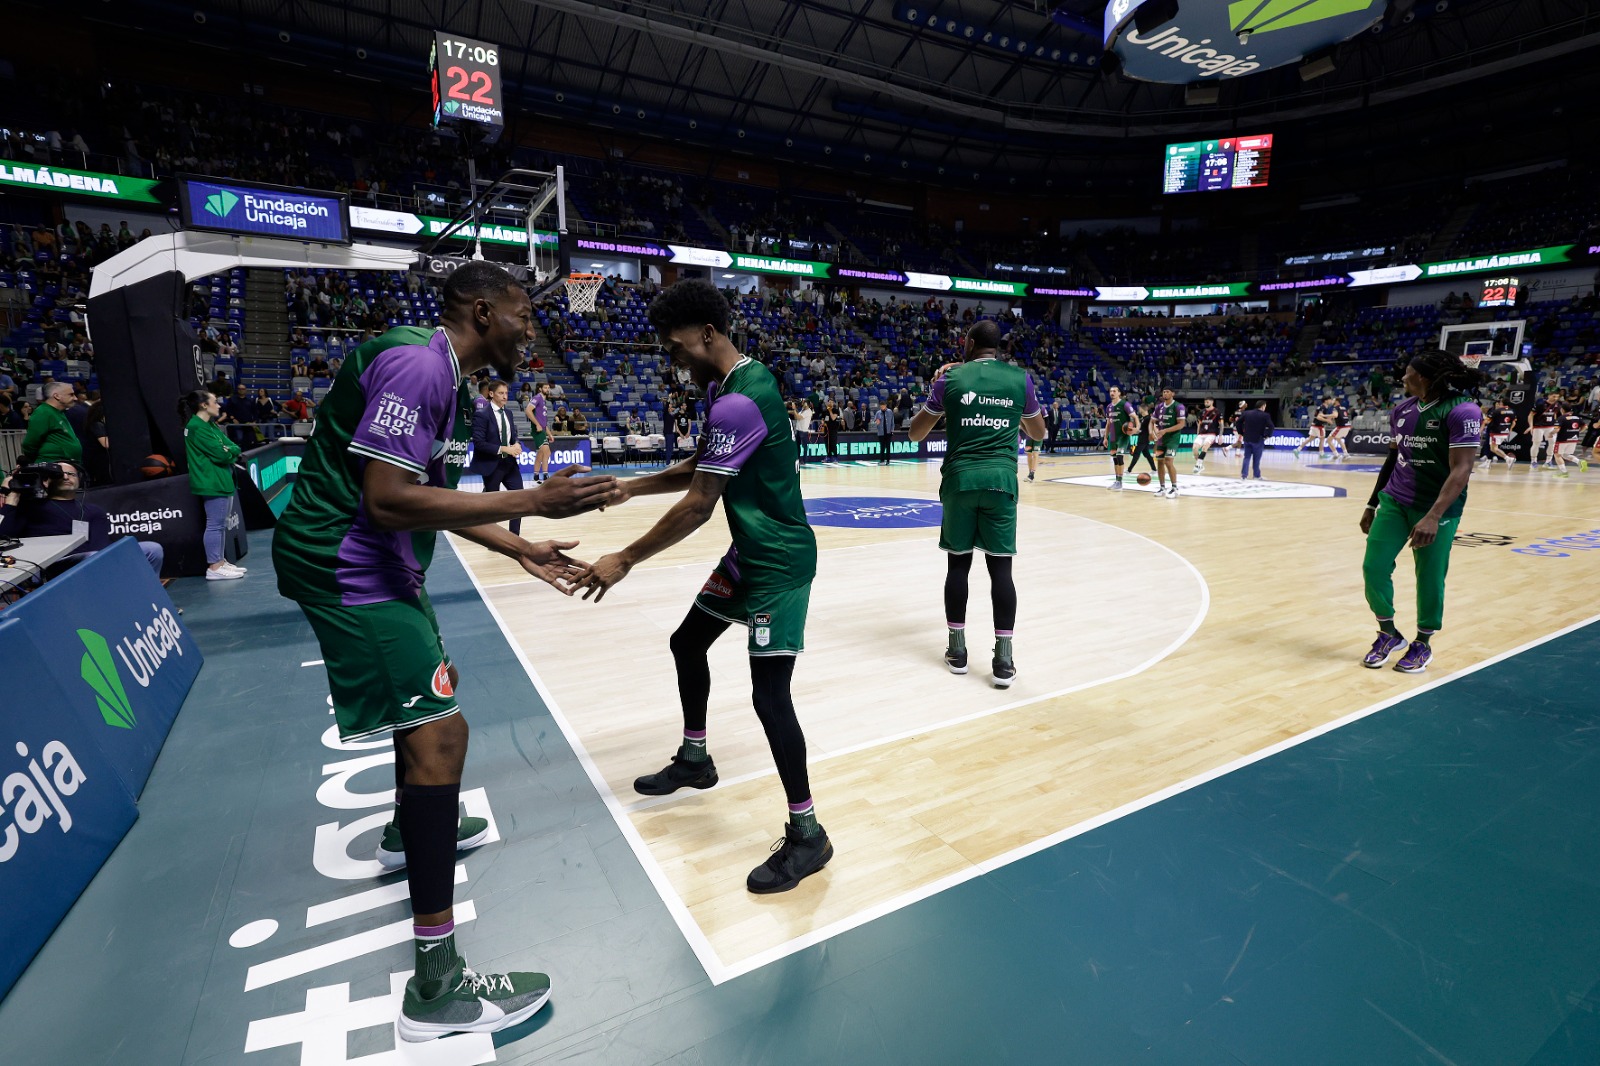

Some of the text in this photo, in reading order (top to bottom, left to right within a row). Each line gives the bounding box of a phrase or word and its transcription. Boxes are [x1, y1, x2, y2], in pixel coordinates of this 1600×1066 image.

[443, 40, 499, 66] 17:06
[1126, 26, 1260, 77] Unicaja
[446, 66, 494, 105] 22
[462, 103, 502, 117] Fundación
[462, 109, 492, 122] Unicaja
[244, 195, 328, 217] Fundación
[245, 208, 307, 229] Unicaja
[578, 240, 615, 251] PARTIDO
[616, 244, 658, 256] DEDICADO
[738, 257, 813, 274] BENALMÁDENA
[838, 268, 866, 278] PARTIDO
[867, 272, 897, 281] DEDICADO
[956, 280, 1014, 293] BENALMÁDENA
[1260, 282, 1294, 291] PARTIDO
[1295, 278, 1336, 288] DEDICADO
[1427, 252, 1541, 275] BENALMÁDENA
[1484, 278, 1509, 286] 17:06
[1152, 286, 1230, 298] BENALMÁDENA
[1482, 287, 1504, 300] 22
[382, 392, 405, 403] sabor
[978, 396, 1014, 408] Unicaja
[372, 406, 415, 437] laga
[1404, 440, 1428, 450] Unicaja
[116, 602, 183, 688] Unicaja
